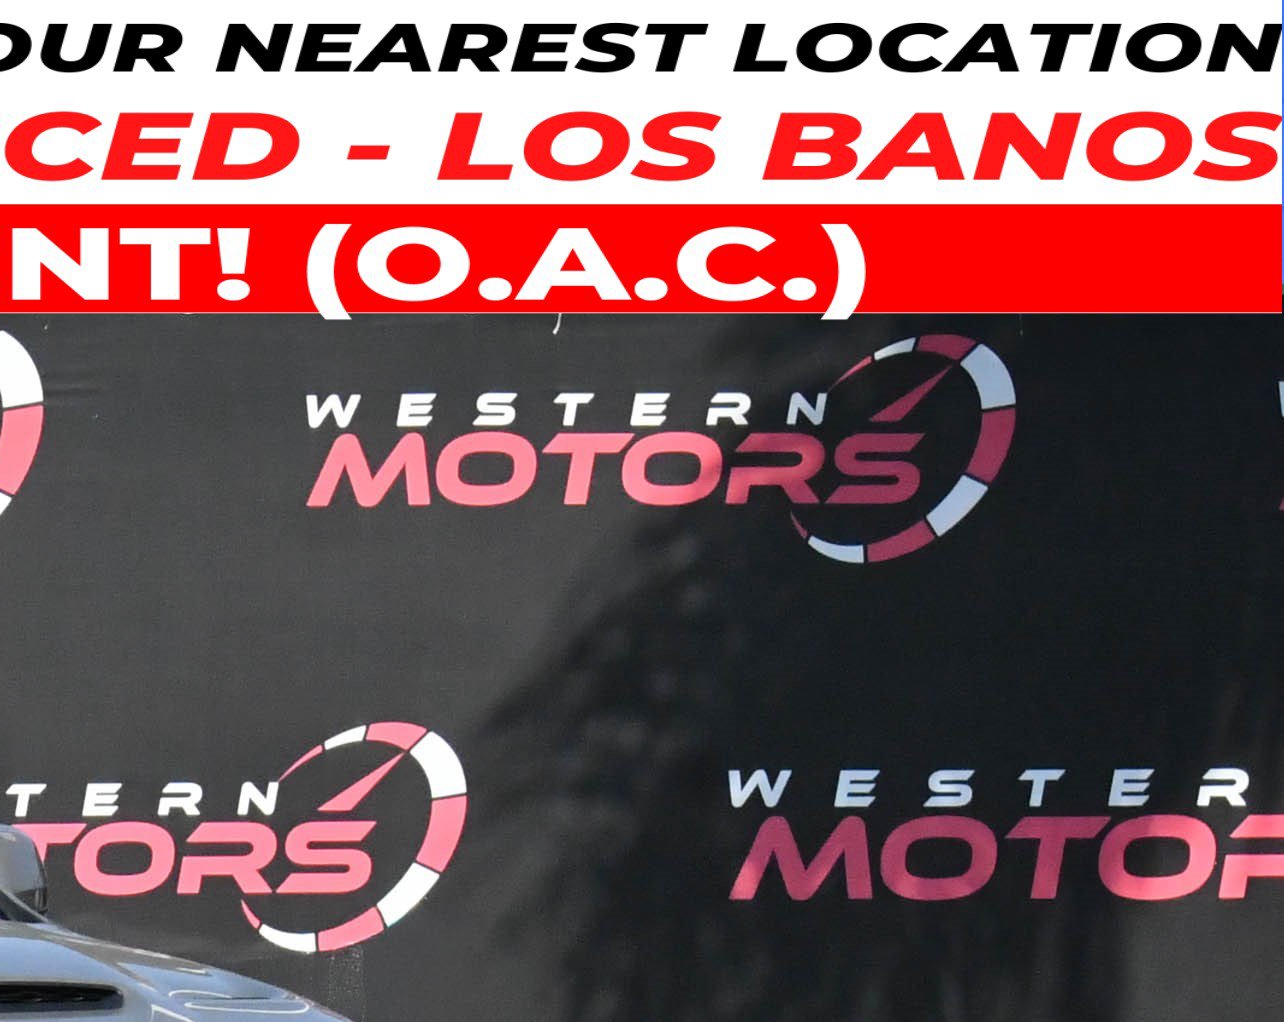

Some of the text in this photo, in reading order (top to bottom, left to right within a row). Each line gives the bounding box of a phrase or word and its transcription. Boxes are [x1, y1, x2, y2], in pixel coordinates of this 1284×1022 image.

[306, 392, 827, 428] WESTERN
[306, 430, 924, 507] MOTORS
[728, 767, 1250, 807] WESTER
